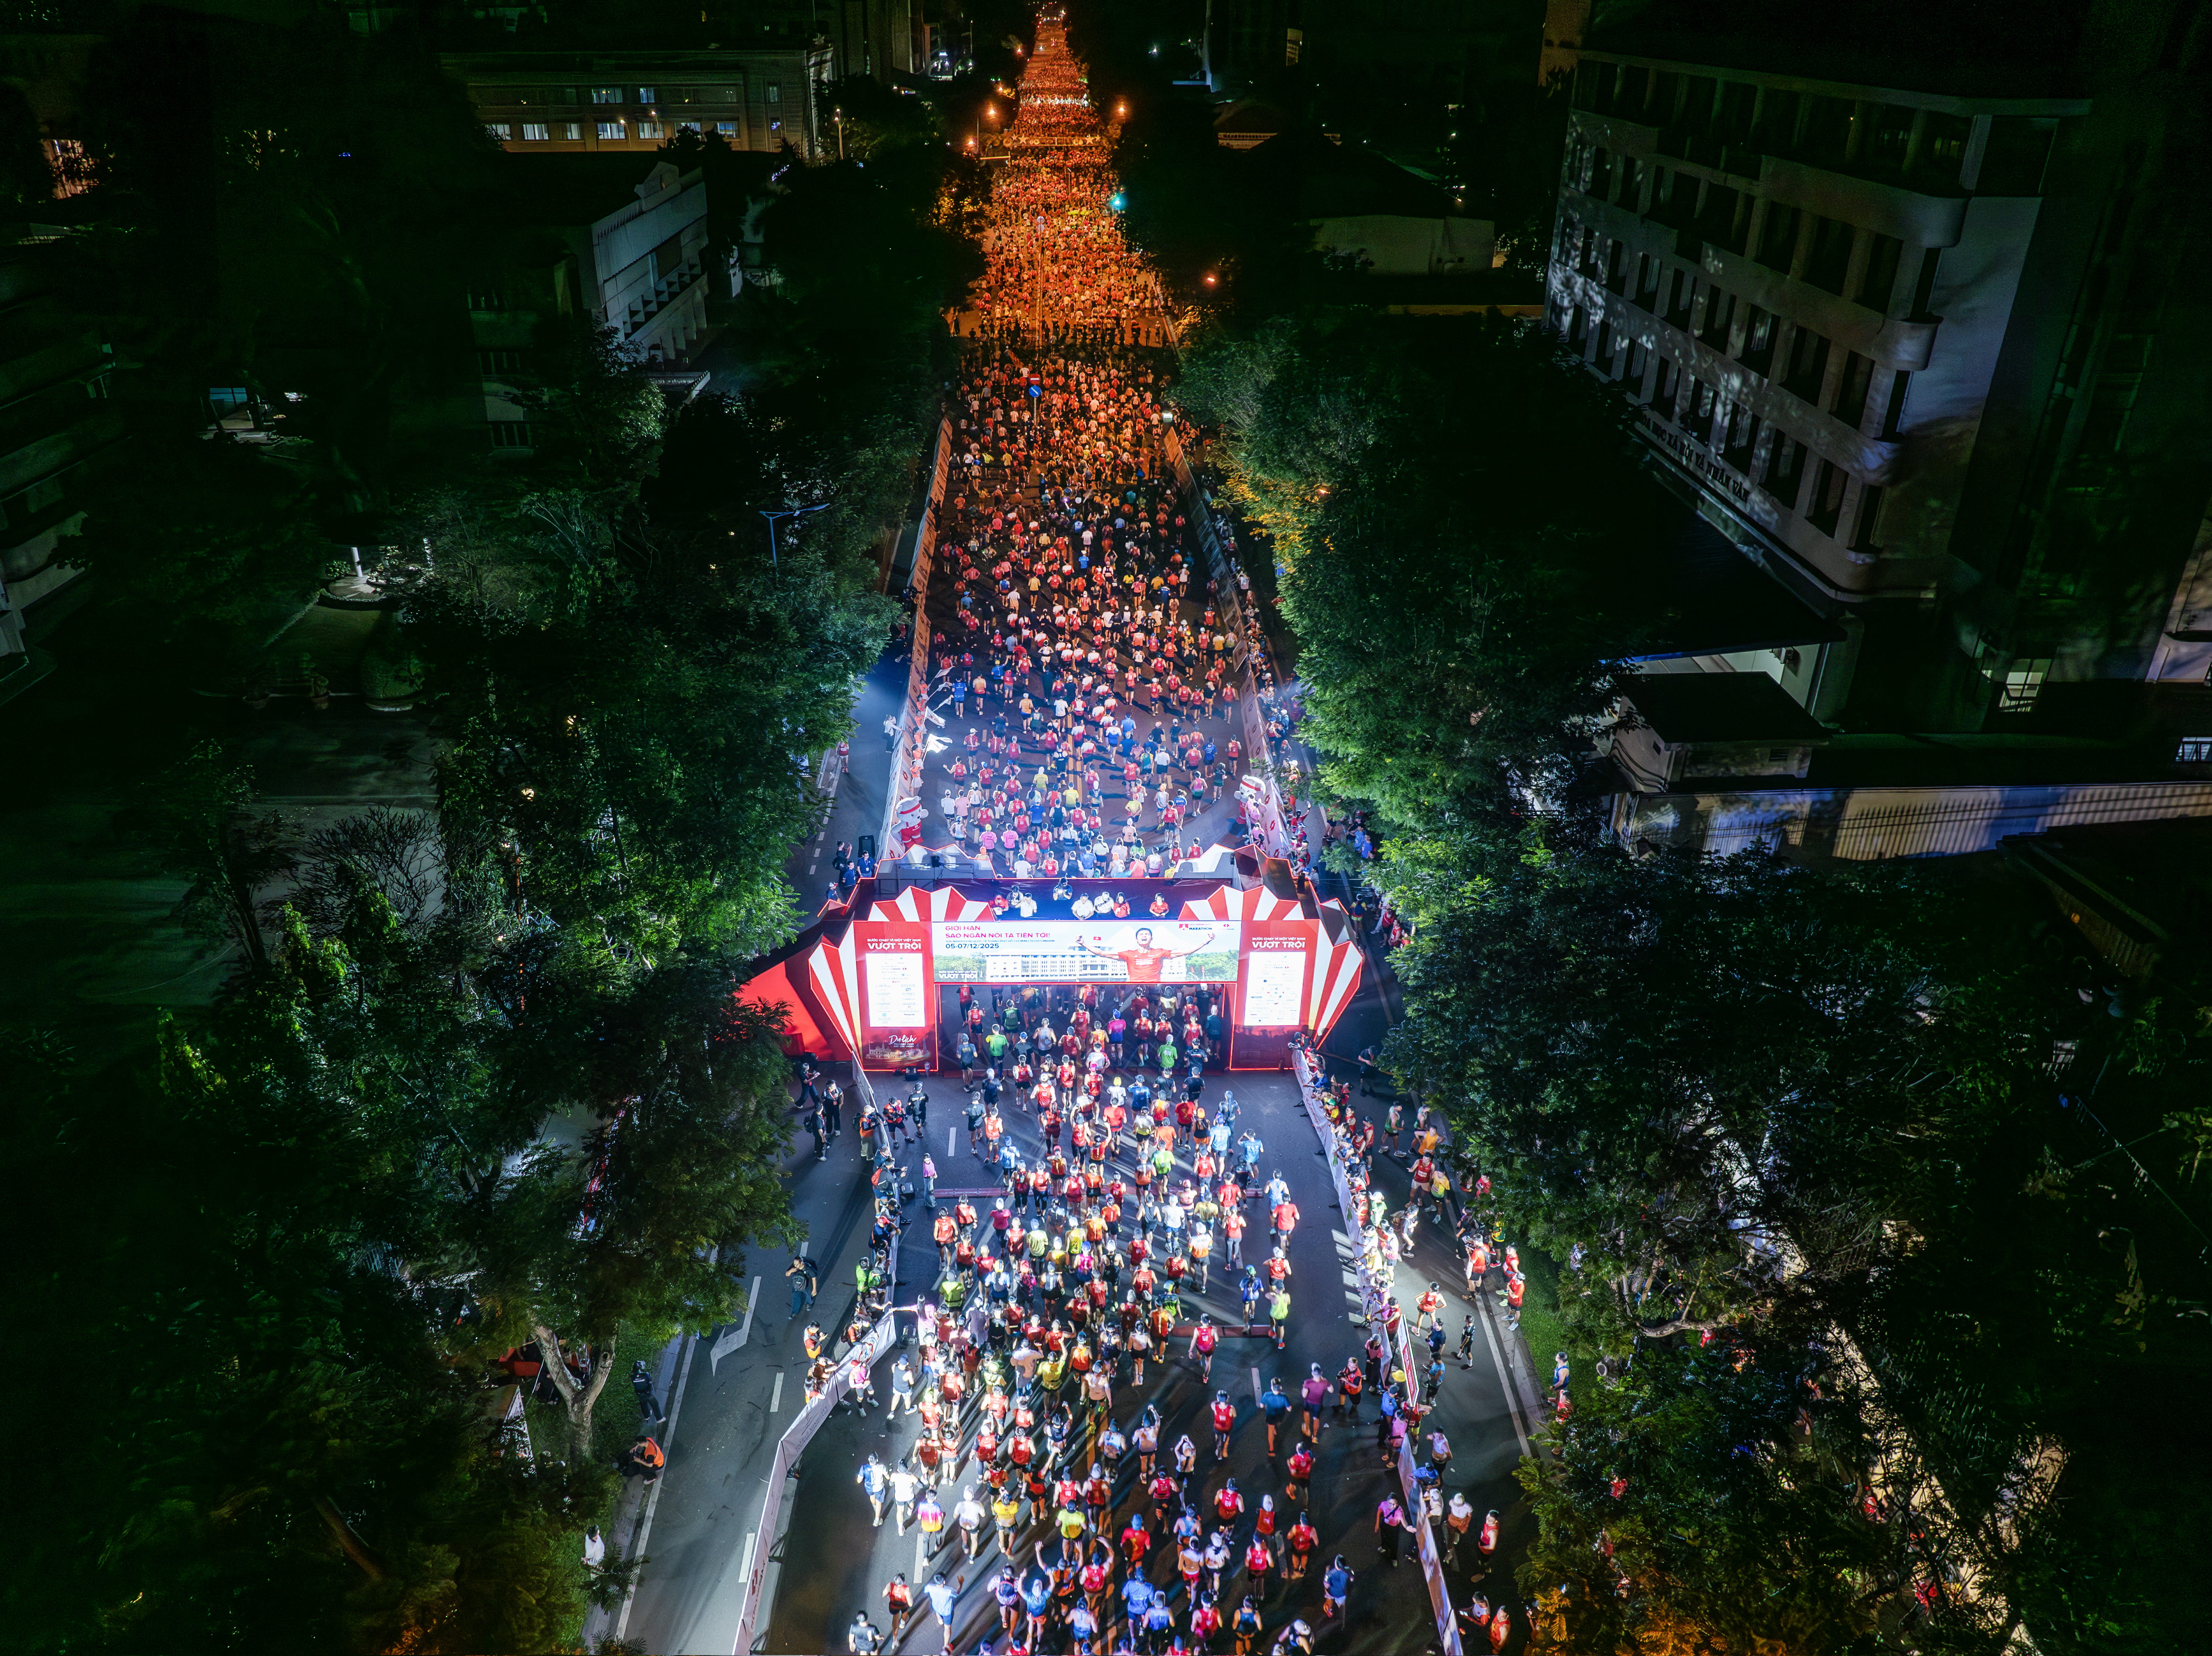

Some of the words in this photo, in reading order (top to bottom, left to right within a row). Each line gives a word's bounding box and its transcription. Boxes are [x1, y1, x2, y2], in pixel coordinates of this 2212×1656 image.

[867, 942, 896, 950] VƯỢT
[898, 942, 921, 950] TRỘI
[1252, 941, 1280, 949] VƯỢT
[1282, 940, 1305, 949] TRỘI
